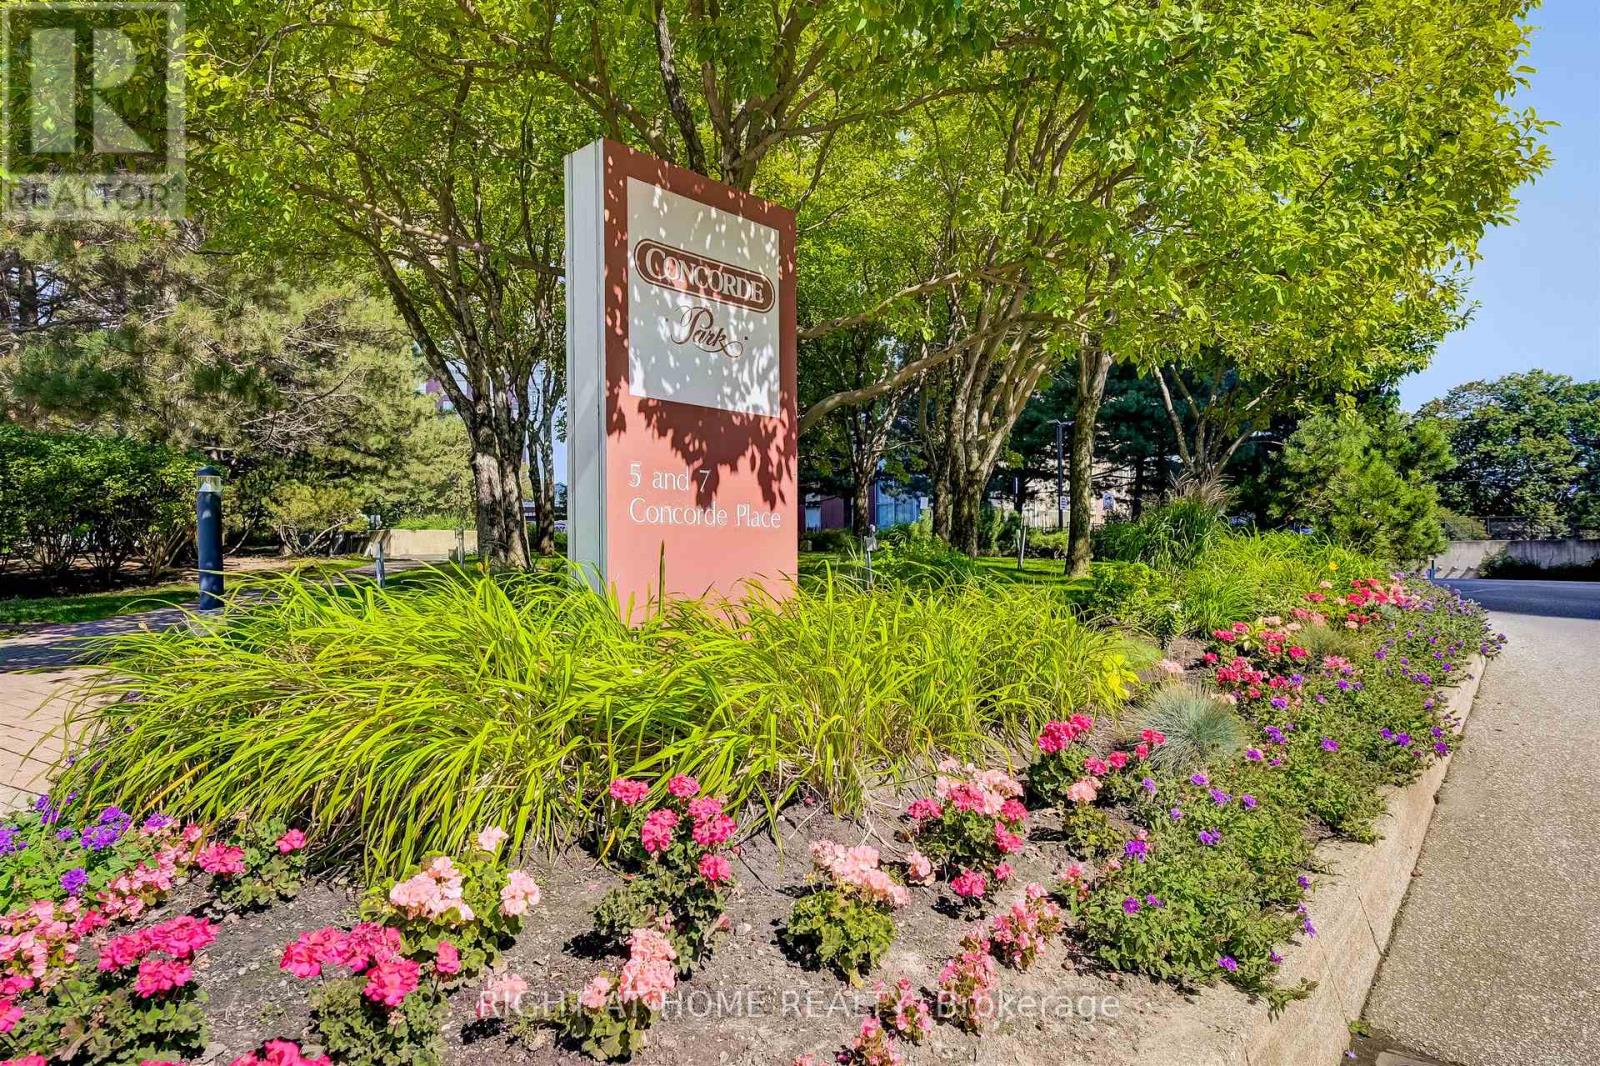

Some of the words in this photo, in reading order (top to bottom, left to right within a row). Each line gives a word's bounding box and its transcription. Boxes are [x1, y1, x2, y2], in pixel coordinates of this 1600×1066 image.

[645, 247, 764, 303] CONCORDE
[671, 306, 744, 358] Park
[629, 462, 642, 488] 5
[652, 466, 690, 491] and
[699, 469, 712, 493] 7
[629, 497, 728, 528] Concorde
[736, 503, 781, 529] Place
